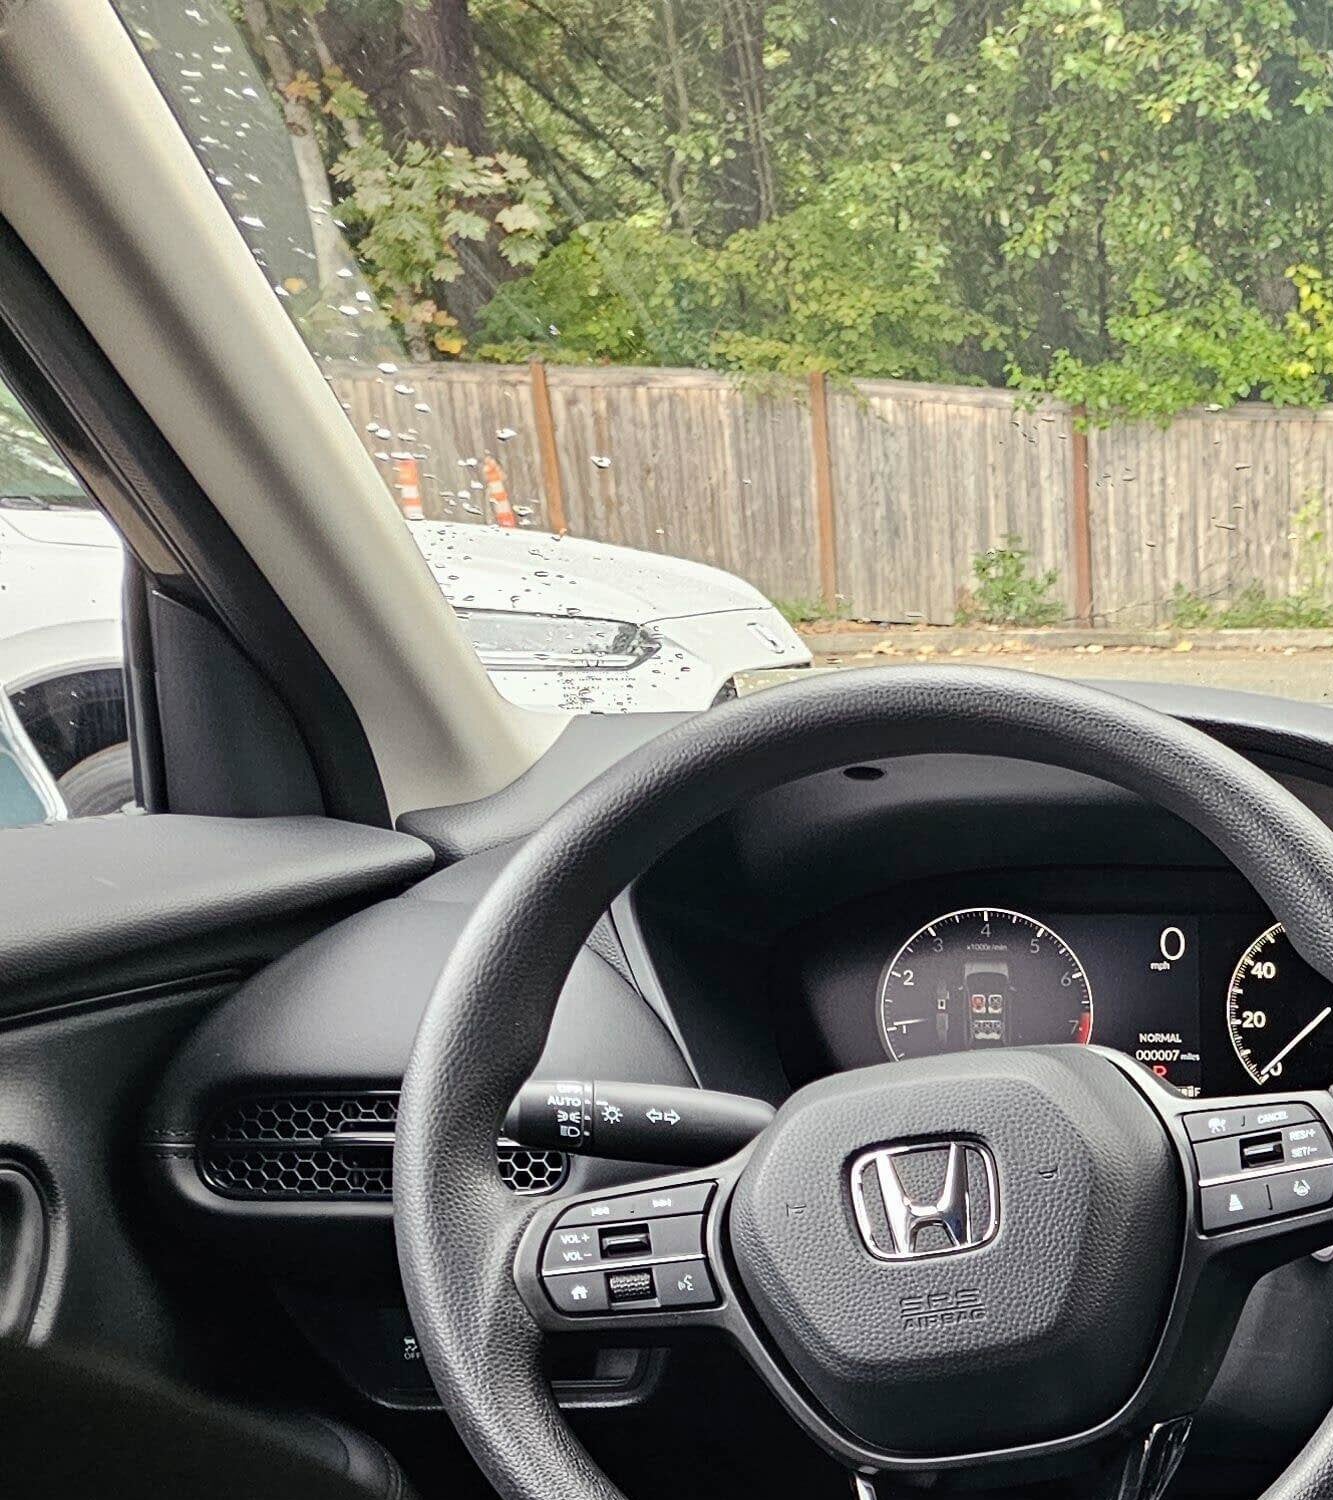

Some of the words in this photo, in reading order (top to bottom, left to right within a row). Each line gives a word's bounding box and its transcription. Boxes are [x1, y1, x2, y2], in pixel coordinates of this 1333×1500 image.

[980, 923, 992, 938] 4
[932, 938, 944, 953] 3
[1029, 938, 1041, 954] 5
[1159, 926, 1186, 961] 0
[1150, 961, 1171, 972] mph
[1250, 961, 1277, 980] 40
[902, 969, 915, 986] 2
[1060, 971, 1072, 987] 6
[1241, 1010, 1267, 1029] 20
[1068, 1020, 1079, 1035] 7
[1138, 1033, 1183, 1043] NORMAL
[1135, 1049, 1181, 1061] 000007
[547, 1095, 582, 1107] AUTO
[1257, 1110, 1289, 1125] CANCEL
[560, 1234, 581, 1245] VOL
[562, 1251, 584, 1262] VOL
